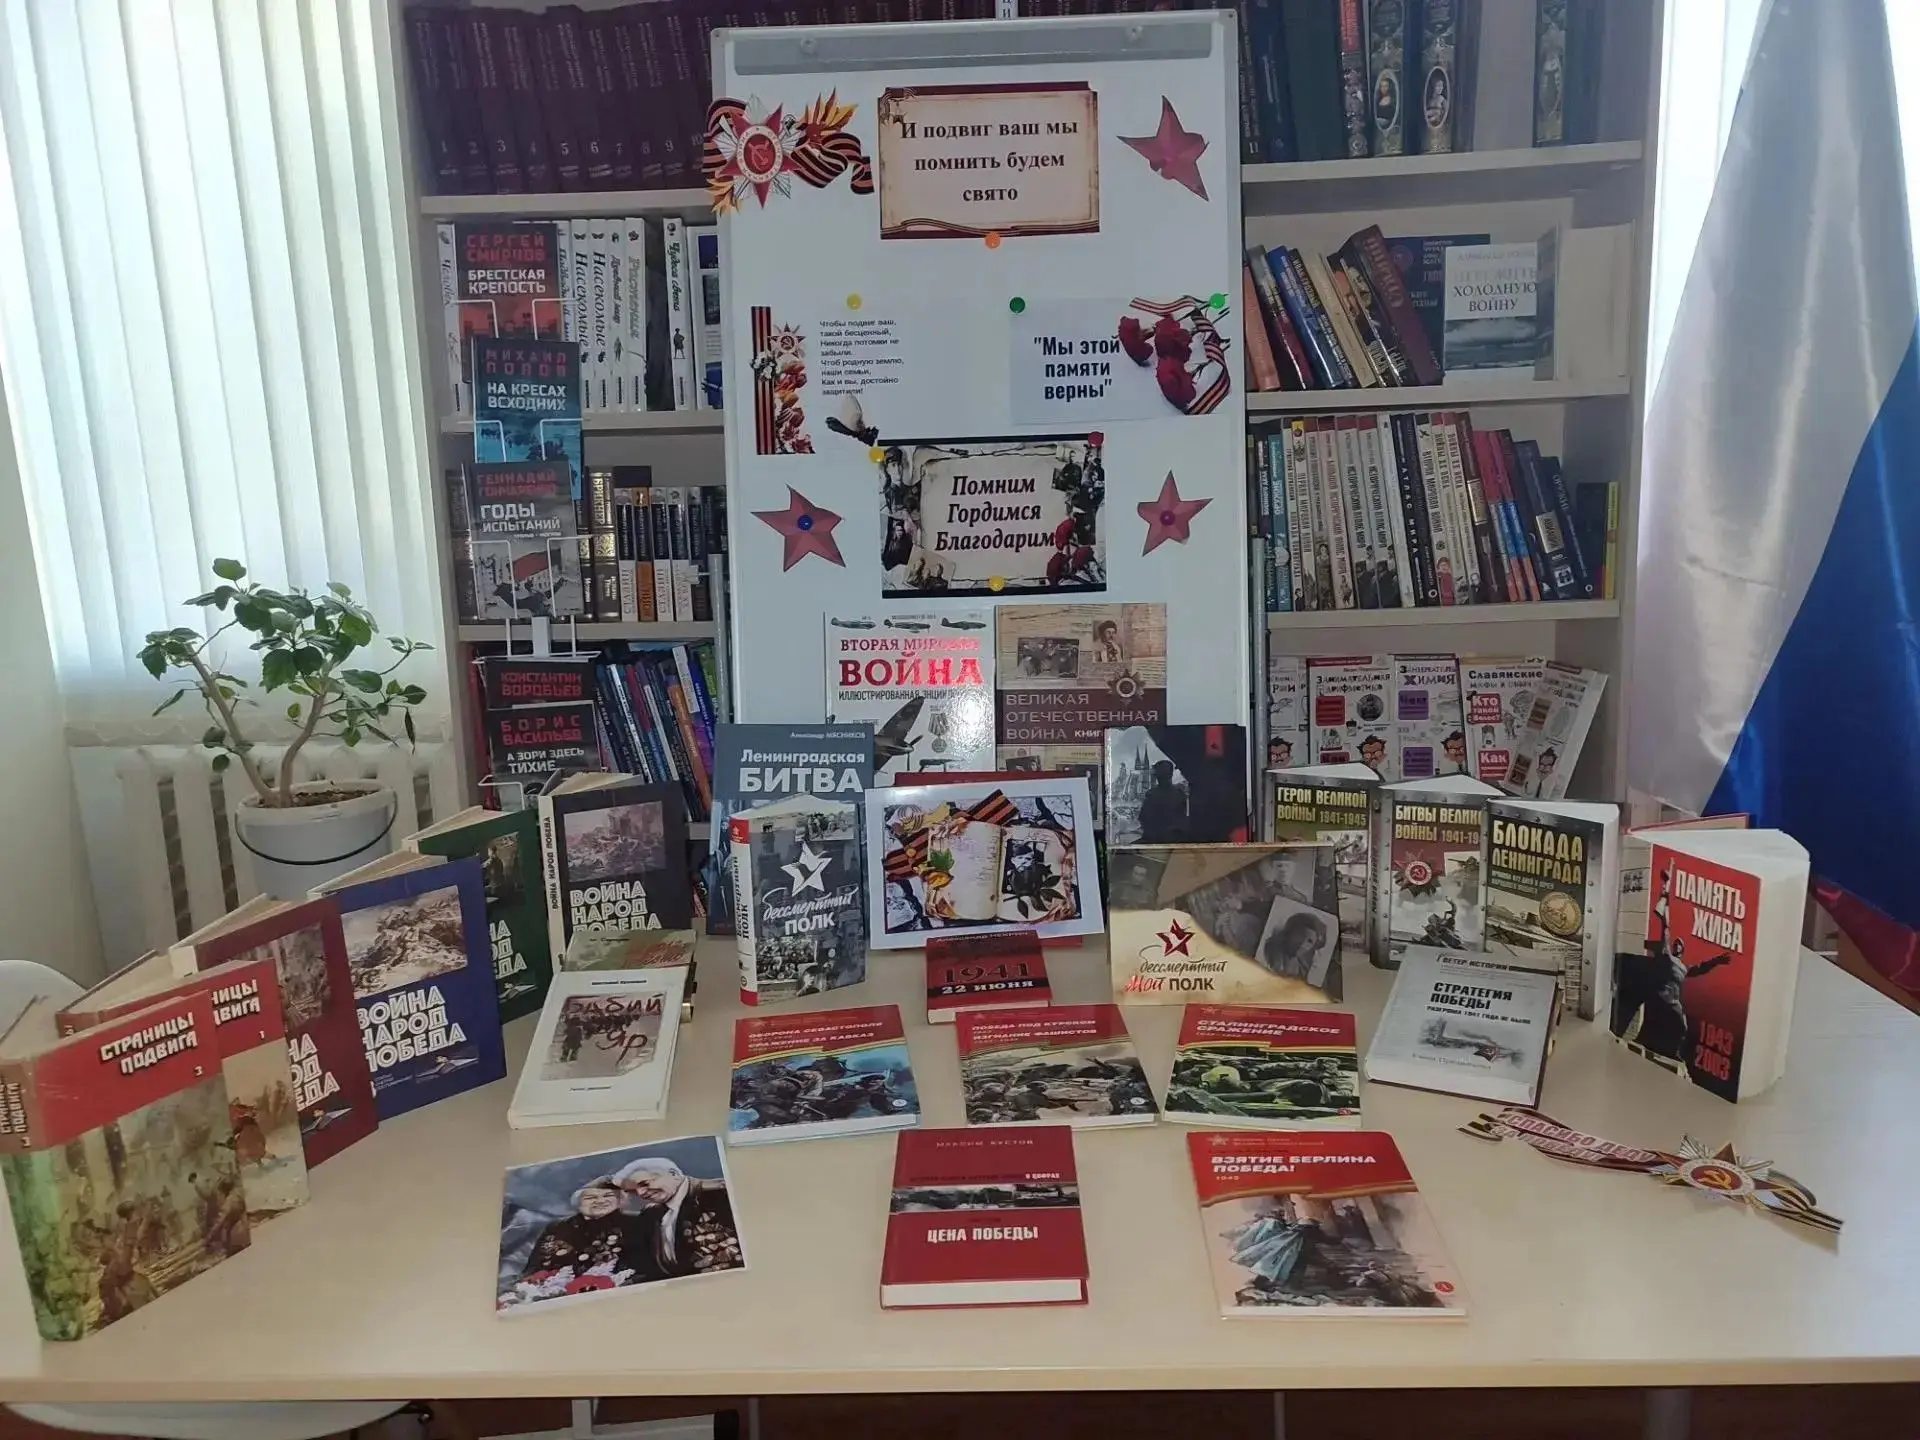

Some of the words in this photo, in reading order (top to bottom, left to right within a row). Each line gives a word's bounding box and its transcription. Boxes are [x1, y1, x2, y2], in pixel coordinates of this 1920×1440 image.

[901, 122, 916, 139] И
[923, 124, 993, 139] подвиг
[999, 122, 1040, 137] ваш
[1046, 121, 1079, 135] мы
[914, 156, 1001, 171] помнить
[1007, 151, 1065, 172] будем
[962, 187, 1018, 202] свято
[467, 232, 545, 249] СЕРГЕЙ
[468, 268, 545, 281] БРЕСТСКАЯ
[468, 280, 546, 294] КРЕПОСТЬ
[1454, 282, 1537, 296] ХОЛОДНУЮ
[575, 251, 588, 349] Насекомые
[593, 251, 606, 348] Насекомые
[1468, 298, 1518, 312] ВОЙНУ
[1080, 335, 1120, 355] этой
[1045, 361, 1111, 378] памяти
[860, 376, 899, 385] достойно
[487, 383, 508, 395] НА
[511, 383, 567, 397] КРЕСАХ
[1044, 379, 1113, 403] верны"
[487, 396, 566, 411] ВСХОДНИХ
[951, 476, 1036, 496] Помним
[480, 503, 535, 520] ГОДЫ
[947, 501, 1042, 527] Гордимся
[1402, 467, 1413, 509] АТЛАС
[1408, 518, 1419, 554] МИРА
[482, 517, 561, 533] ИСПЫТАНИЙ
[935, 528, 1056, 553] Благодарим
[841, 639, 899, 651] ВТОРАЯ
[839, 651, 984, 687] ВОЙНА
[1468, 670, 1543, 680] Славянские
[501, 672, 582, 684] КОНСТАНТИН
[839, 689, 920, 700] ИЛЛЮСТРИРОВАННАЯ
[1006, 694, 1089, 705] ВЕЛИКАЯ
[1473, 696, 1498, 706] Кто
[501, 715, 581, 732] БОРИС
[1006, 710, 1158, 722] ОТЕЧЕСТВЕННАЯ
[503, 730, 582, 746] ВАСИЛЬЕВ
[1006, 726, 1067, 739] ВОЙНА
[507, 752, 516, 761] А
[517, 750, 547, 761] ЗОРИ
[549, 747, 585, 759] ЗДЕСЬ
[741, 749, 865, 766] Ленинградская
[1480, 753, 1507, 763] Как
[740, 767, 863, 793] БИТВА
[1278, 787, 1312, 803] ГЕРОИ
[1316, 789, 1367, 808] ВЕЛИКОЙ
[1278, 804, 1315, 821] ВОЙНЫ
[1319, 810, 1367, 826] 1941-1945
[1395, 805, 1436, 822] БИТВЫ
[1395, 823, 1437, 841] ВОЙНЫ
[1493, 820, 1583, 862] БЛОКАДА
[1492, 848, 1582, 885] ЛЕНИНГРАДА
[570, 881, 646, 907] ВОЙНА
[1675, 869, 1746, 920] ПАМЯТЬ
[572, 898, 648, 925] НАРОД
[1692, 908, 1743, 953] ЖИВА
[941, 985, 967, 994] 22
[974, 981, 1034, 991] ИЮНЯ
[1433, 982, 1513, 1001] СТРАТЕГИЯ
[357, 985, 445, 1030] ВОЙНА
[1430, 993, 1491, 1010] ПОБЕДЫ
[260, 1031, 265, 1039] 1
[1197, 1020, 1341, 1034] СТАЛИНГРАДСКОЕ
[1197, 1025, 1284, 1036] СРАЖЕНИЕ
[100, 1011, 195, 1062] СТРАНИЦЫ
[120, 1030, 198, 1075] ПОДВИГА
[194, 1066, 203, 1077] 3
[1508, 1114, 1596, 1146] СПАСИБО
[1211, 1155, 1283, 1164] ВЗЯТИЕ
[1289, 1156, 1377, 1164] БЕРЛИНА
[1213, 1164, 1295, 1174] ПОБЕДА!
[927, 1228, 967, 1244] ЦЕНА
[973, 1227, 1039, 1241] ПОБЕДЫ
